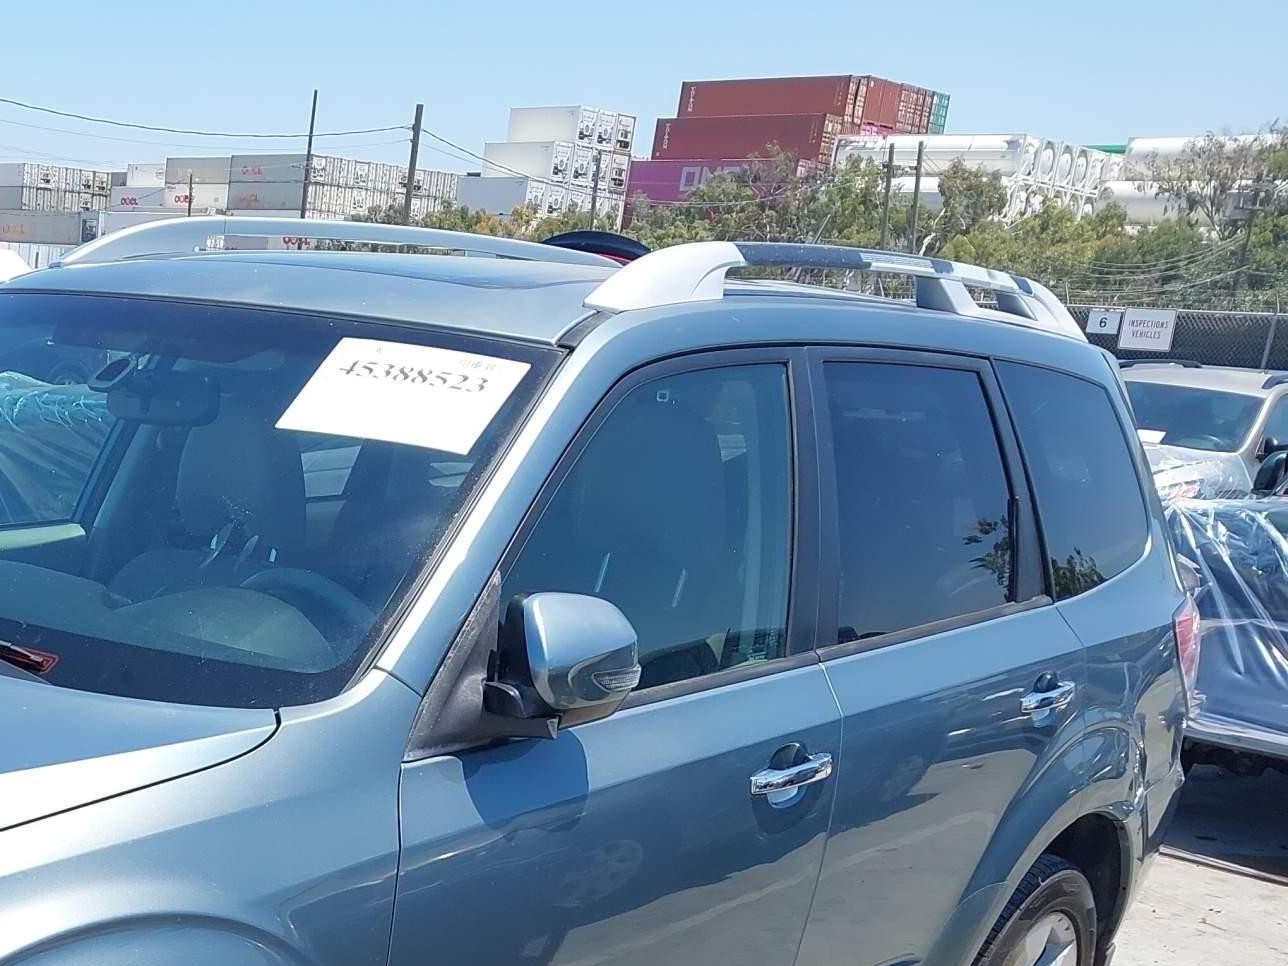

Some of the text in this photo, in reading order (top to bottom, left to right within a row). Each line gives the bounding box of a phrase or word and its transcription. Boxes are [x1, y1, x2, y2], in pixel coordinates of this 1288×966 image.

[1099, 317, 1108, 328] 6
[1128, 320, 1169, 329] INSPECTIONS
[1132, 331, 1161, 339] VEHICLES
[339, 360, 489, 392] 45388523
